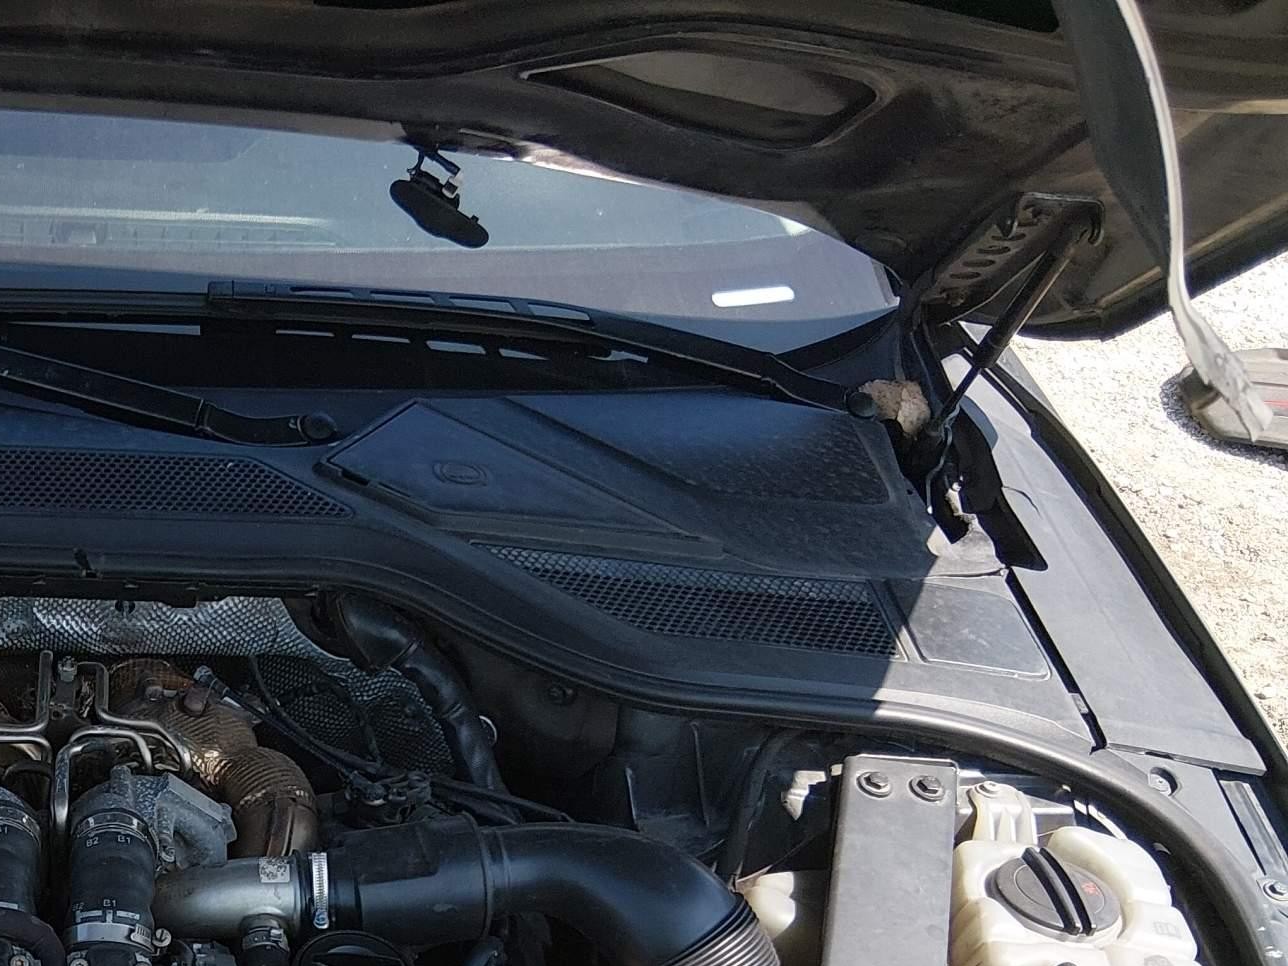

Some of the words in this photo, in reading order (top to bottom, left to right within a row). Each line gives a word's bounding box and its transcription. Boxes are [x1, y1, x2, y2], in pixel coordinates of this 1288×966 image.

[86, 836, 100, 848] B2
[117, 834, 131, 845] B1
[103, 899, 117, 908] B1
